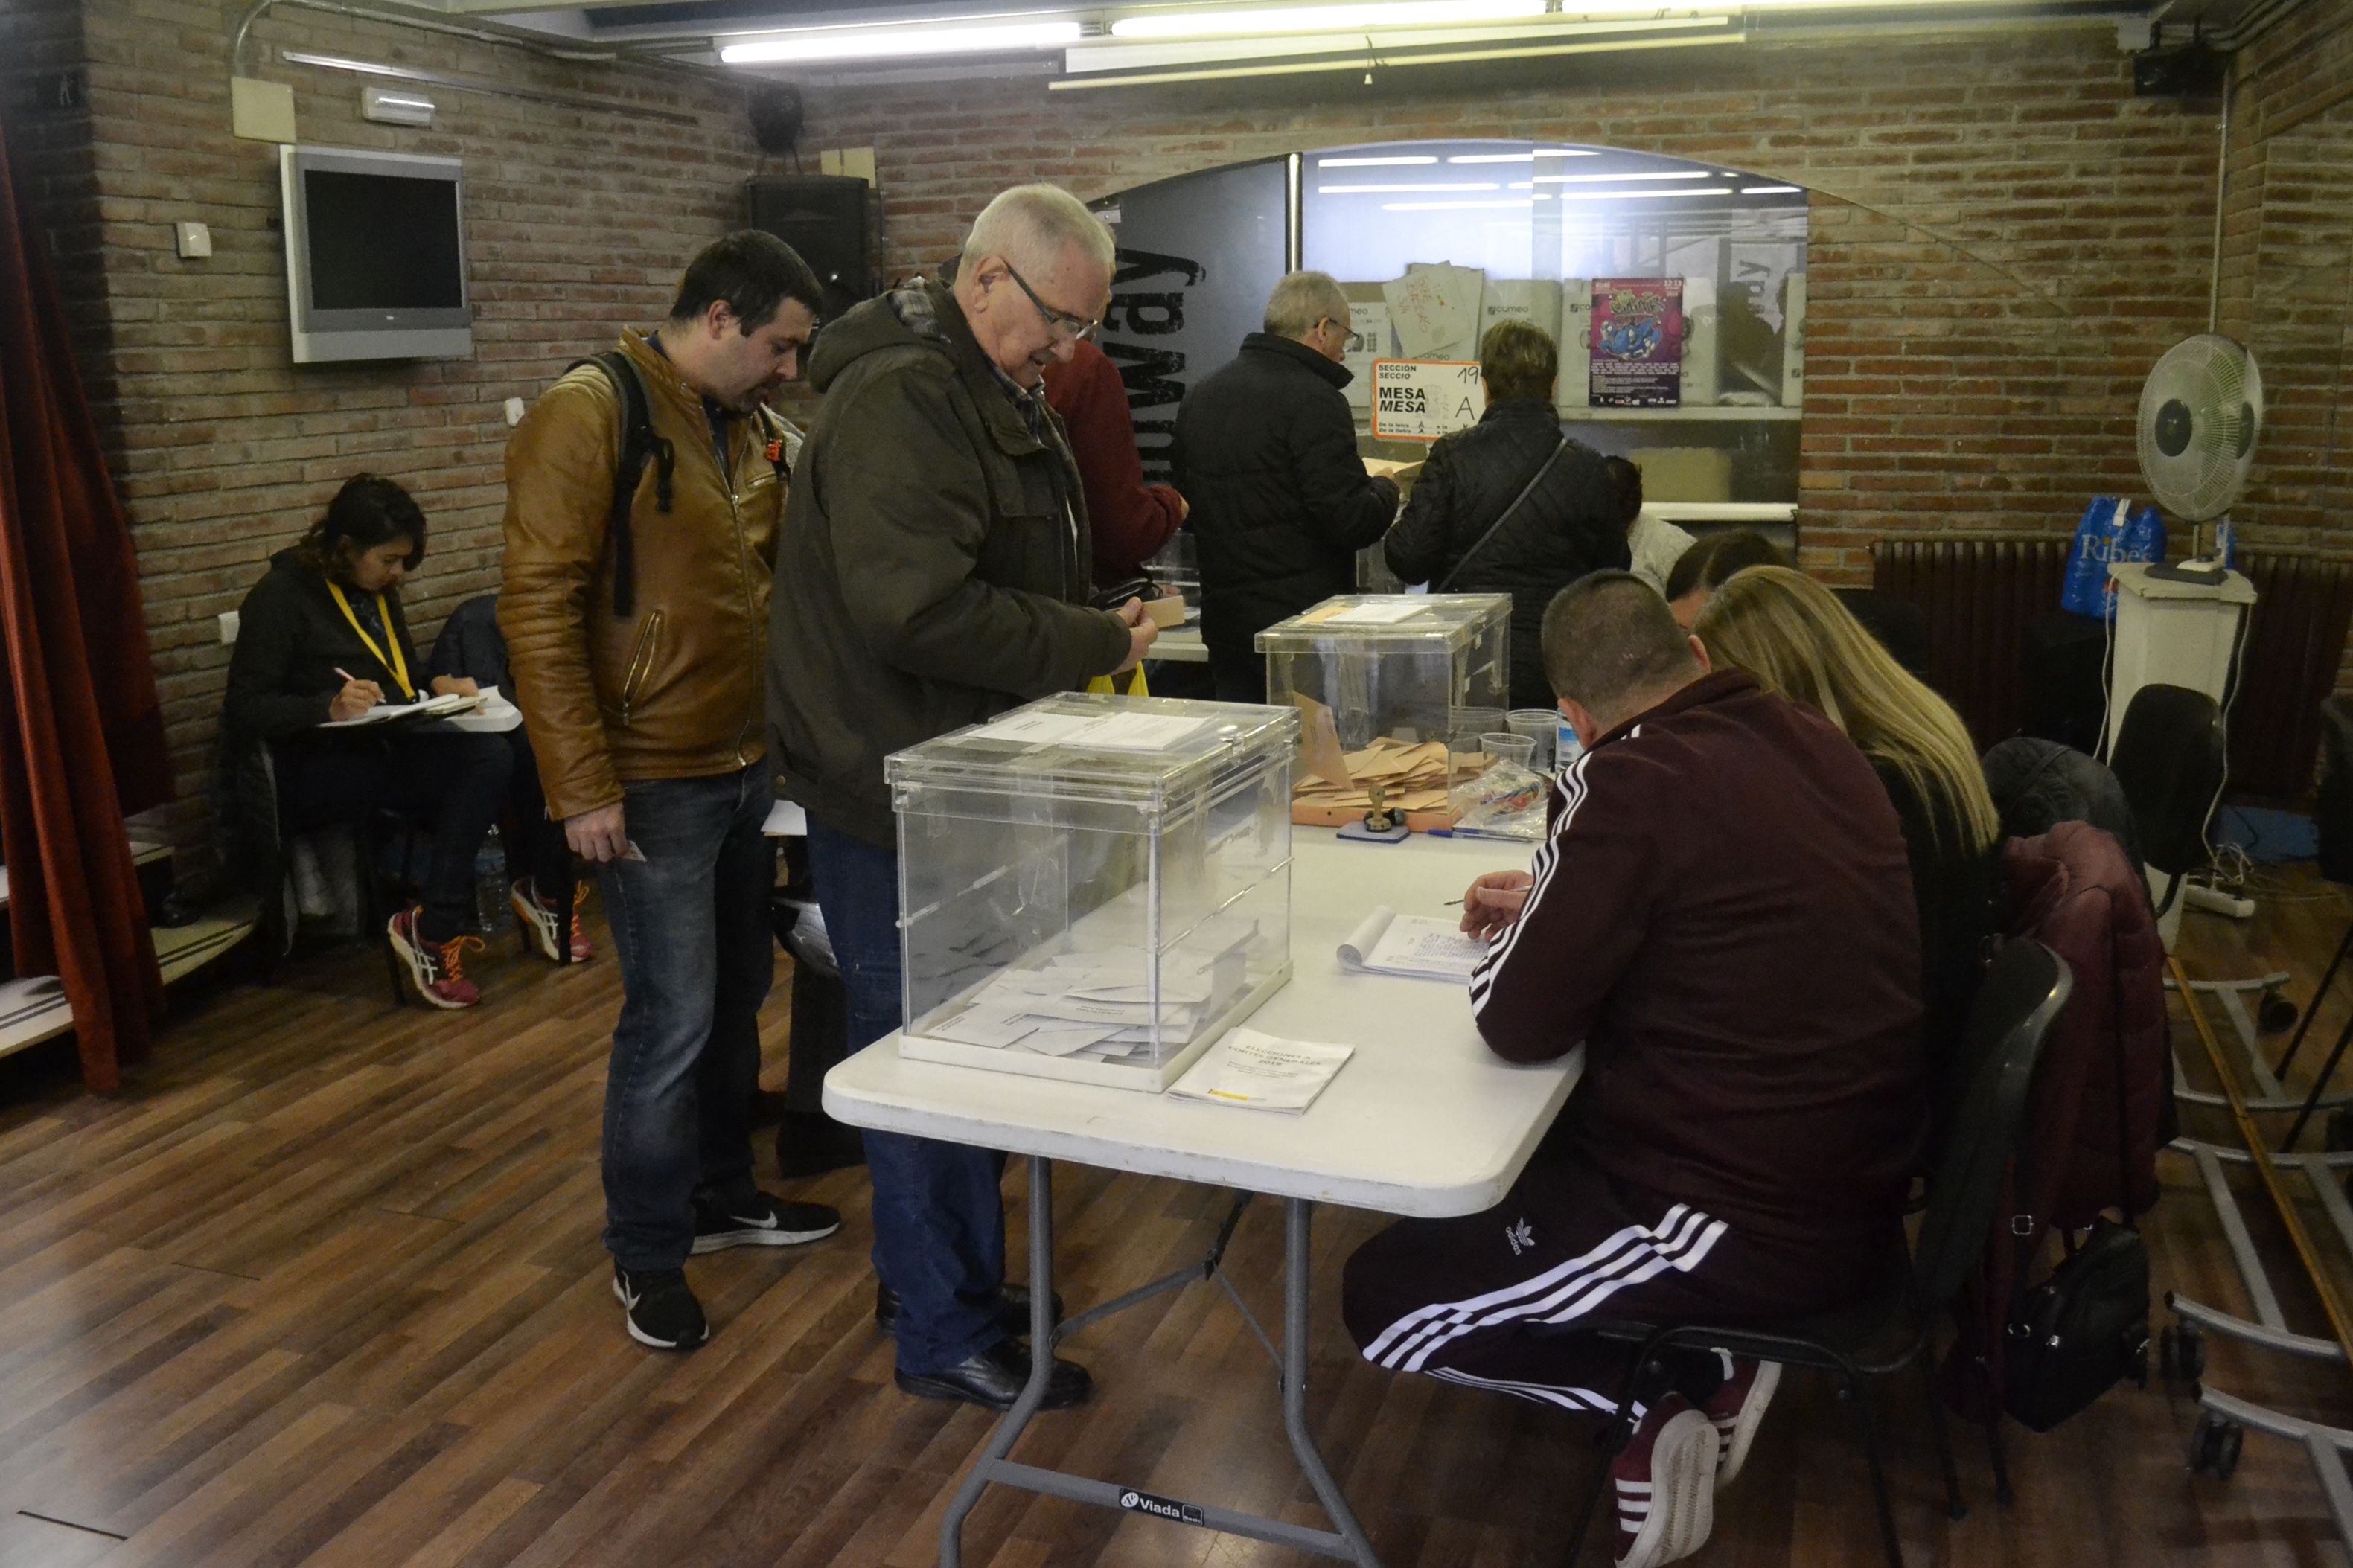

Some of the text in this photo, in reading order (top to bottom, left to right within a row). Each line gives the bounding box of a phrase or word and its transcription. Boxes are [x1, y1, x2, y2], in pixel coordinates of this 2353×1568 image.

[1457, 366, 1479, 385] 19
[1379, 387, 1426, 400] MESA
[1379, 400, 1426, 413] MESA
[1455, 396, 1475, 420] A
[1227, 1046, 1321, 1066] CORTES GENERALES
[1505, 1226, 1522, 1255] adidas
[1140, 1497, 1180, 1518] Viada
